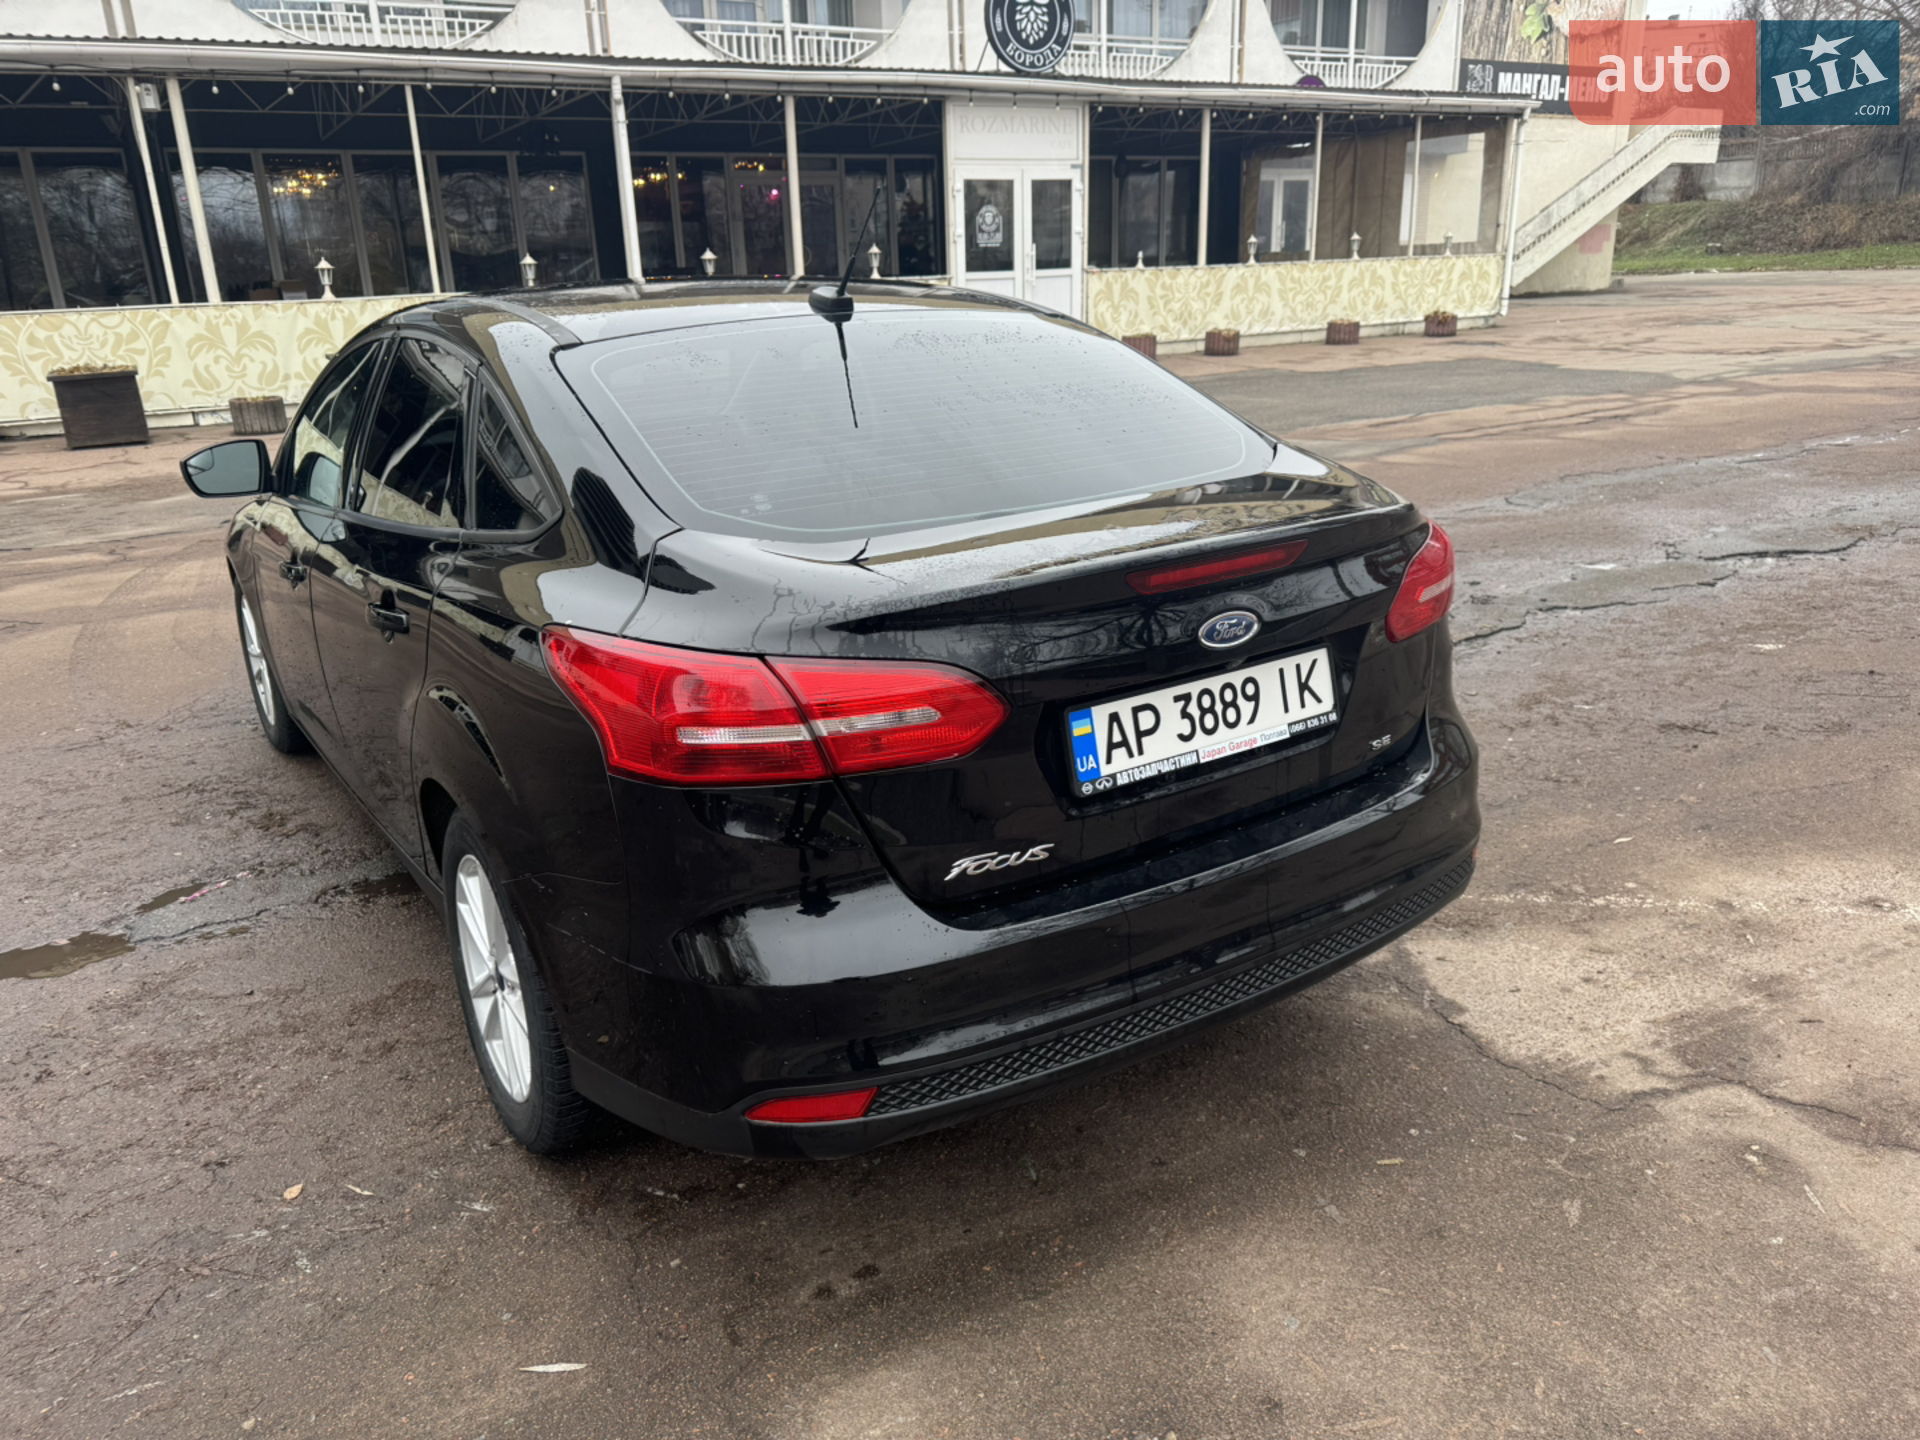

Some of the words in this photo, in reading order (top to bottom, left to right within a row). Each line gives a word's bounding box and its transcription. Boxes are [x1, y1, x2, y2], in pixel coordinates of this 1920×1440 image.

[1006, 42, 1062, 67] БОРОДА
[959, 115, 1074, 134] ROZMARINE
[1213, 618, 1247, 641] Ford
[1105, 703, 1161, 766] AP
[1173, 676, 1261, 743] 3889
[1278, 658, 1323, 714] IK
[1201, 745, 1227, 760] Japan
[1228, 736, 1258, 752] Garage
[1371, 734, 1392, 751] SE
[1076, 756, 1098, 773] UA
[1116, 750, 1198, 786] АВТОЗАПЧАСТИНИ
